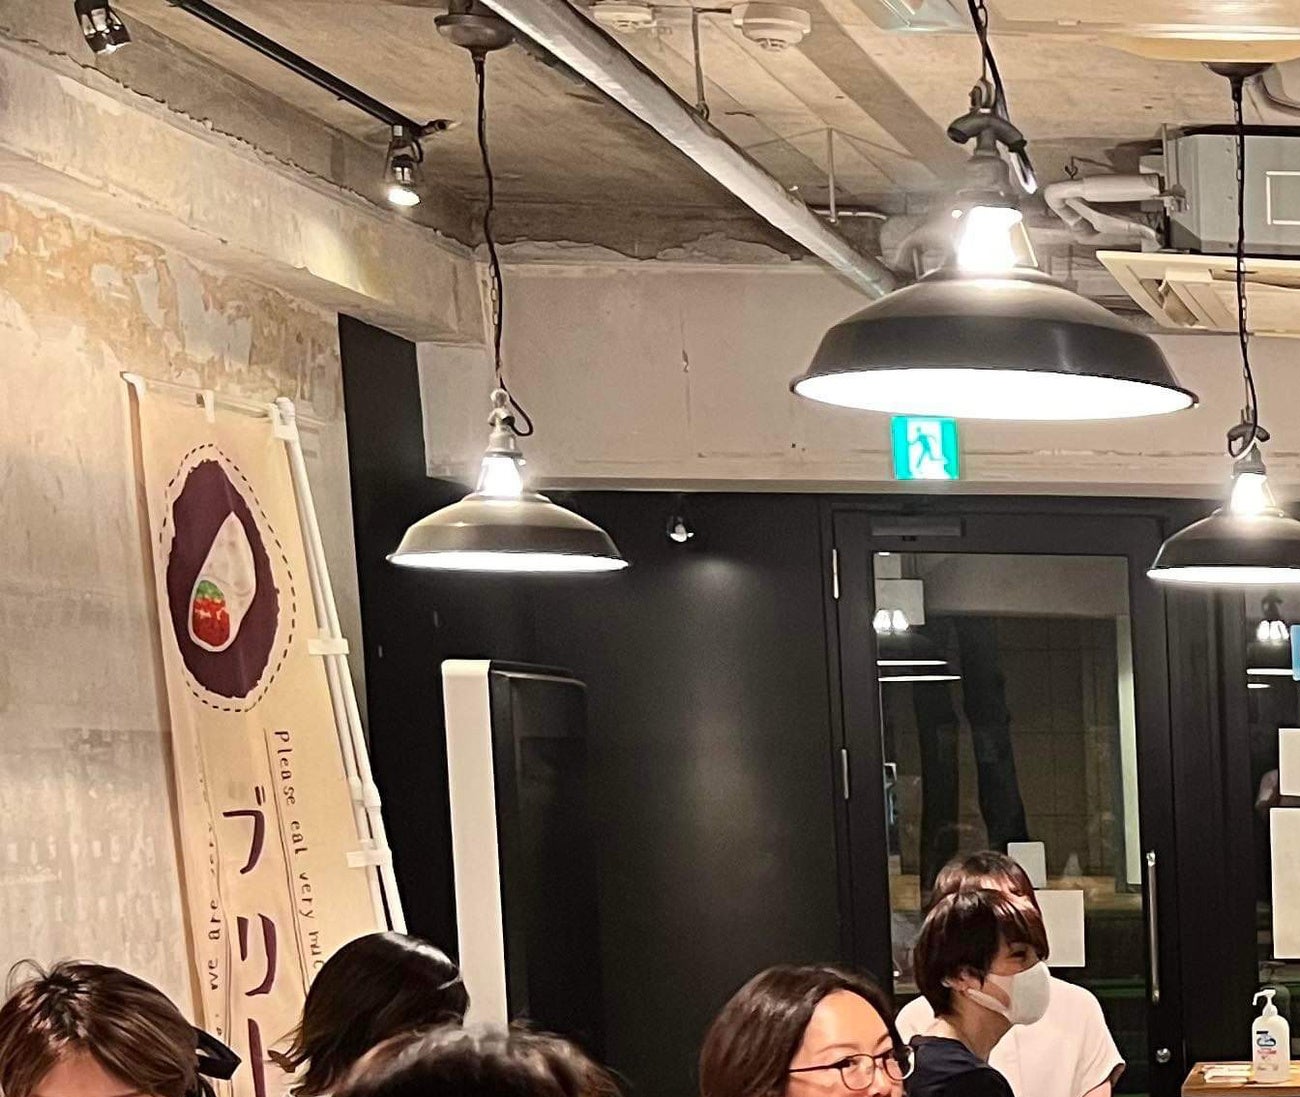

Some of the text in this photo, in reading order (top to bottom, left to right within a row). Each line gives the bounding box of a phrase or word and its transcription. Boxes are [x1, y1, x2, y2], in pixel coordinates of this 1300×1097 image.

[274, 730, 296, 805] Please
[300, 872, 315, 919] very
[308, 931, 325, 970] muc
[208, 900, 221, 941] are
